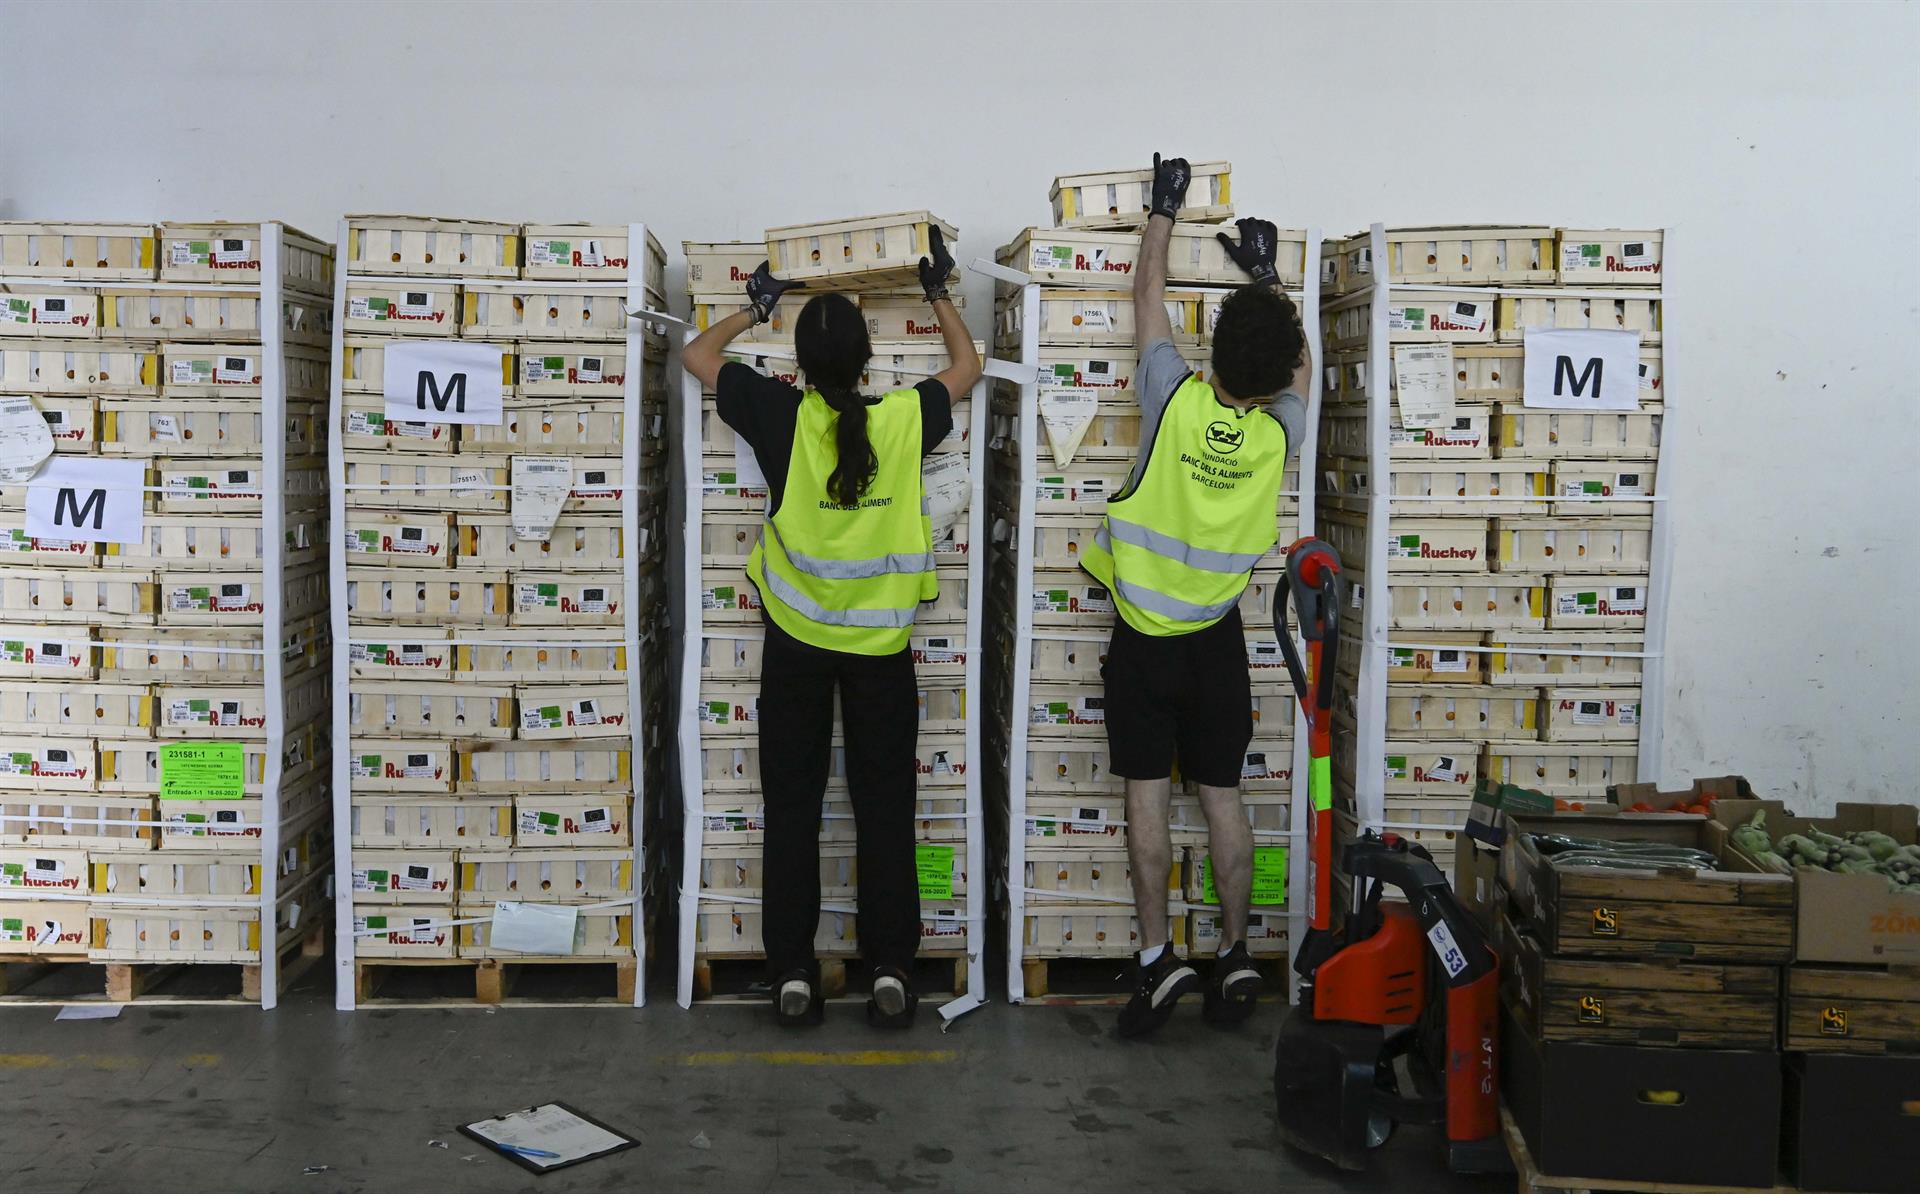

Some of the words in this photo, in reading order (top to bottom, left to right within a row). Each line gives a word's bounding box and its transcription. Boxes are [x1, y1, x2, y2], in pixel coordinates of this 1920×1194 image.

[1554, 355, 1603, 398] M
[417, 370, 467, 413] M
[1180, 453, 1201, 468] BANC
[1200, 462, 1217, 476] DELS
[1218, 468, 1254, 479] ALIMENTS
[1191, 471, 1235, 489] BARCELONA
[54, 488, 106, 529] M
[1421, 543, 1476, 560] Ruchey
[561, 597, 617, 613] Ruy
[209, 710, 265, 727] Rhey
[385, 763, 442, 779] Ruy
